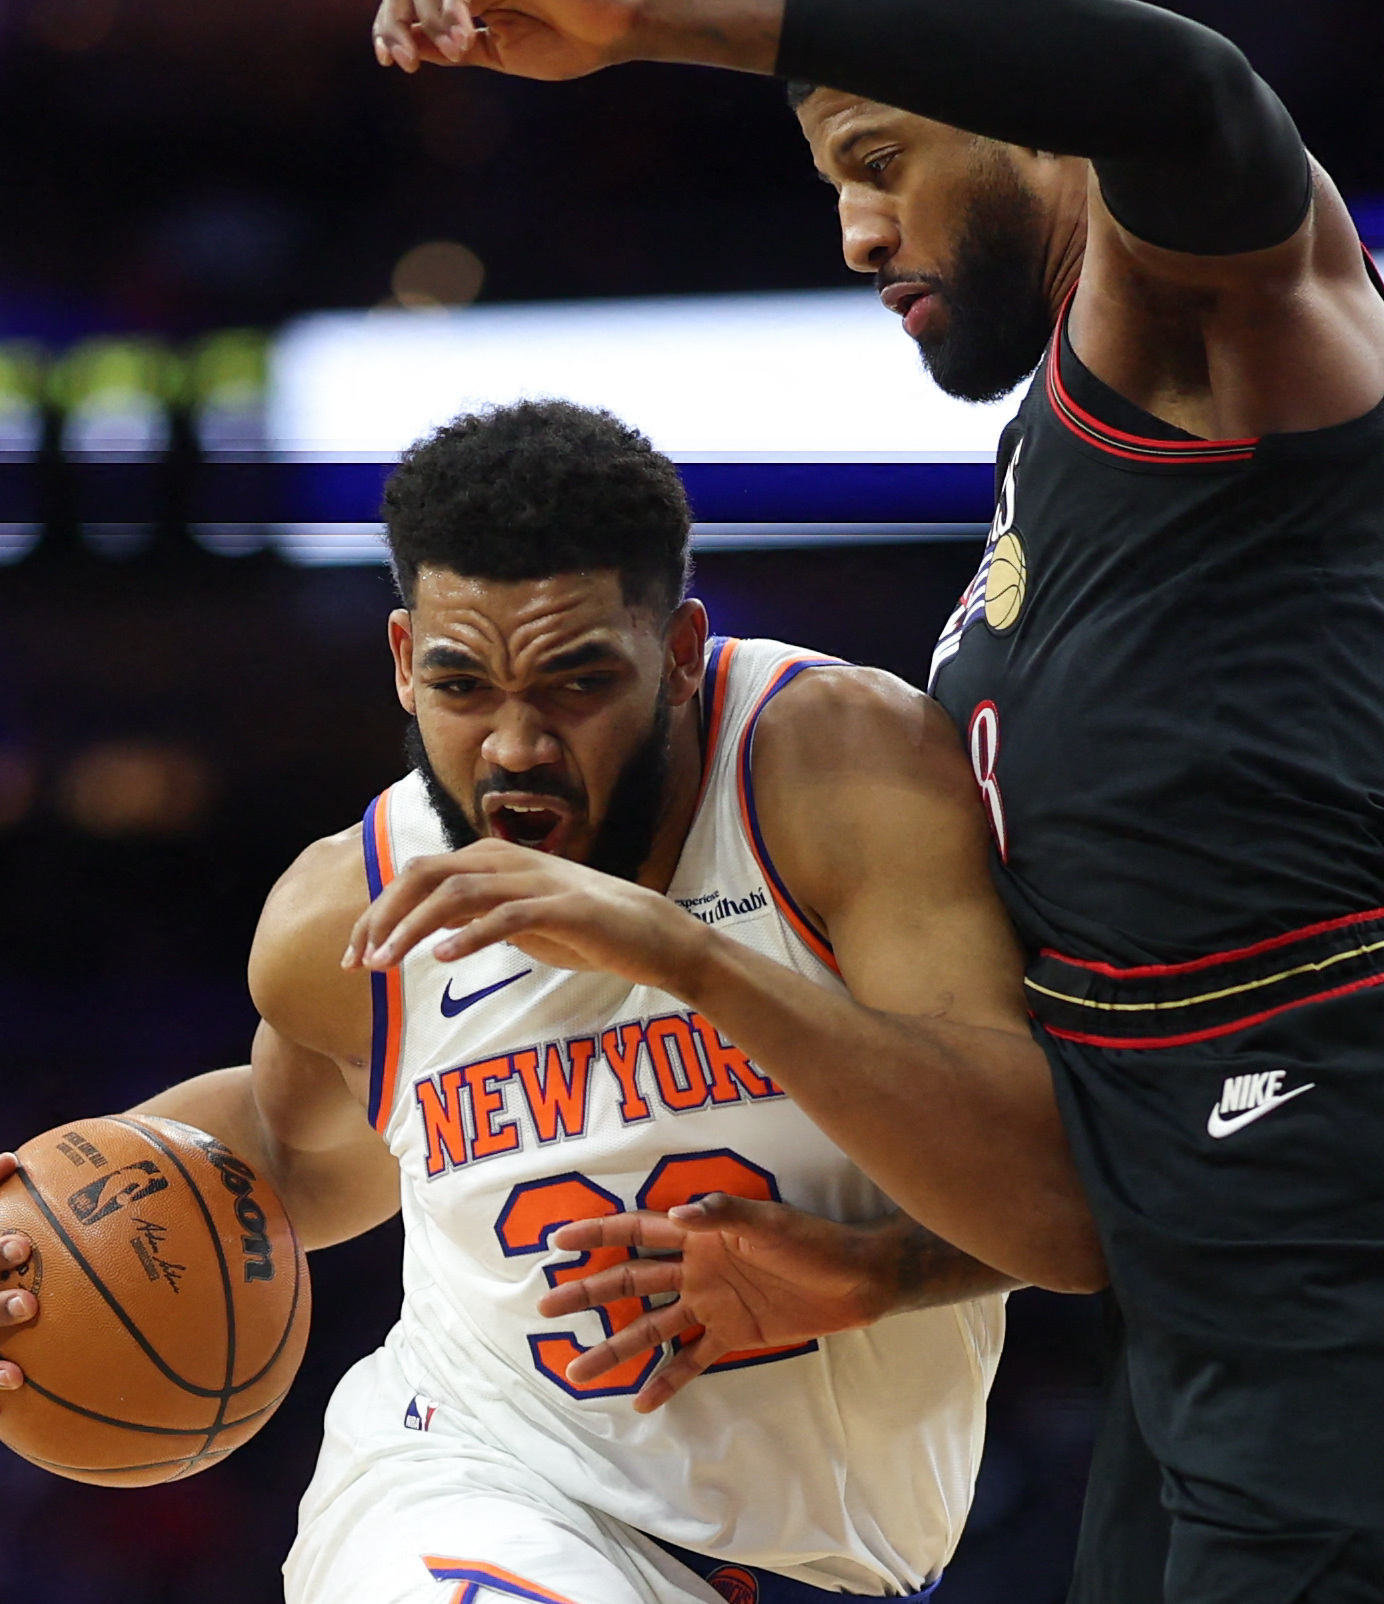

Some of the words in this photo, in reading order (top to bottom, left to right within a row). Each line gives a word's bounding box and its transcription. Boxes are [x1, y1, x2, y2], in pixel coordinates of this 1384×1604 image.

[414, 1037, 596, 1182] NEW
[601, 1011, 788, 1127] YOR
[1220, 1069, 1287, 1114] NIKE
[194, 1137, 276, 1284] lson
